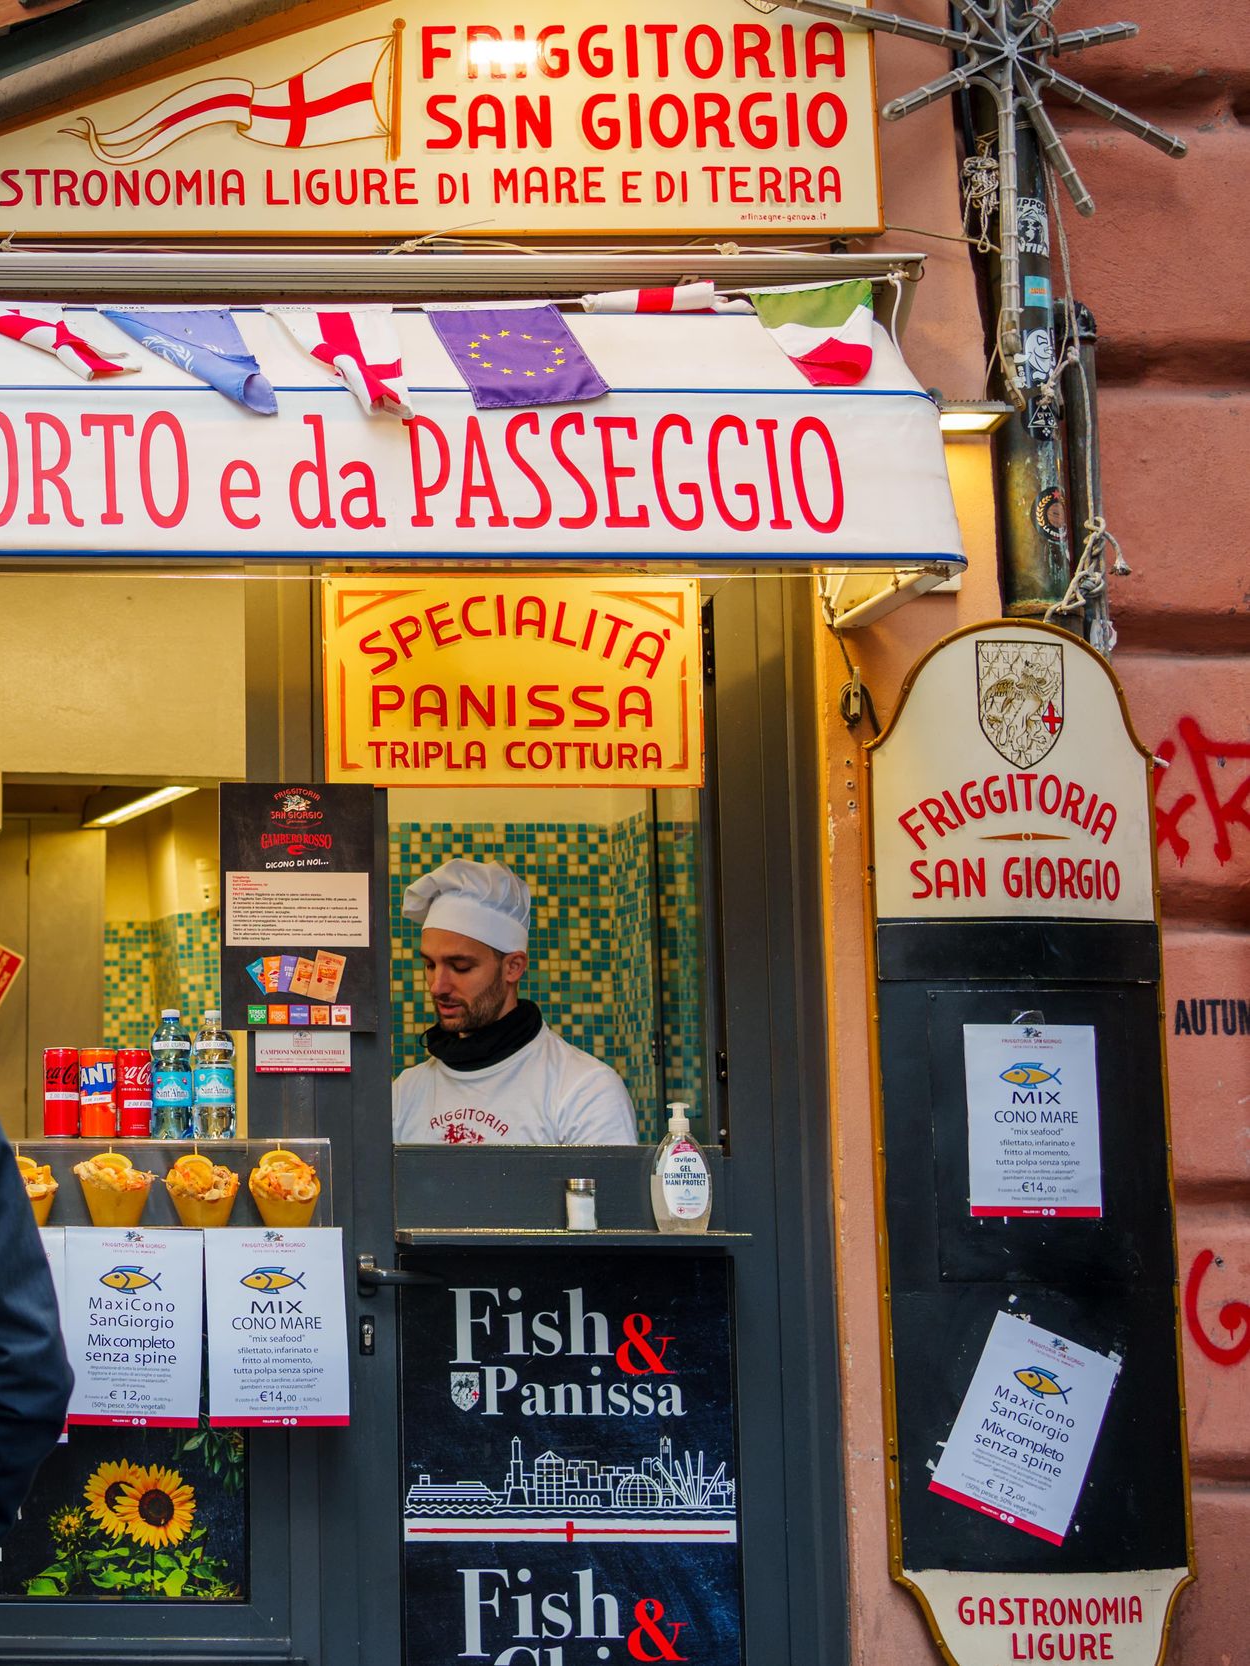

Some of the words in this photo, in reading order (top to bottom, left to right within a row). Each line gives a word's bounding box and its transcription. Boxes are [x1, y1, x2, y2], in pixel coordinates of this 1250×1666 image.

[421, 21, 846, 80] FRIGGITORIA
[425, 93, 552, 150] SAN
[580, 91, 848, 151] GIORGIO
[266, 167, 419, 206] LIGURE
[438, 172, 469, 205] DI
[492, 166, 606, 205] MARE
[621, 171, 642, 204] E
[655, 170, 688, 204] DI
[702, 165, 842, 204] TERRA
[219, 459, 261, 530] e
[288, 414, 387, 530] da
[401, 411, 844, 535] PASSEGGIO
[358, 594, 671, 680] SPECIALITÀ
[371, 684, 653, 728] PANISSA
[367, 740, 487, 769] TRIPLA
[505, 741, 663, 770] COTTURA
[273, 787, 321, 801] FRIGGITORIA
[270, 811, 286, 819] SAN
[287, 811, 324, 819] GIORGIO
[898, 773, 1117, 851] FRIGGITORIA
[260, 833, 303, 849] GAMBERO
[303, 833, 333, 850] ROSSO
[265, 860, 295, 869] DICONO
[910, 857, 986, 899] SAN
[1002, 856, 1120, 901] GIORGIO
[1012, 1091, 1061, 1105] MIX
[429, 1108, 509, 1137] RIGGITORIA
[994, 1110, 1036, 1124] CONO
[1040, 1110, 1079, 1124] MARE
[1016, 1159, 1037, 1167] polpa
[1061, 1159, 1080, 1167] spine
[682, 1179, 706, 1187] PROTECT
[88, 1296, 175, 1313] MaxiCono
[251, 1300, 303, 1315] MIX
[89, 1313, 174, 1332] SanGiorgio
[231, 1316, 277, 1331] CONO
[280, 1316, 323, 1330] MARE
[448, 1287, 615, 1364] Fish
[615, 1313, 676, 1375] &
[87, 1333, 112, 1347] Mix
[113, 1335, 176, 1351] completo
[249, 1334, 268, 1343] "mix
[269, 1334, 305, 1343] seafood"
[85, 1351, 129, 1363] senza
[134, 1351, 177, 1367] spine
[254, 1367, 277, 1375] polpa
[302, 1367, 324, 1375] spine
[109, 1390, 118, 1400] €
[122, 1390, 151, 1402] 12,00
[259, 1391, 297, 1403] €14,00
[480, 1365, 688, 1416] Panissa
[994, 1385, 1076, 1429] MaxiCono
[990, 1401, 1070, 1444] SanGiorgio
[981, 1418, 1006, 1437] Mix
[1007, 1432, 1064, 1461] completo
[974, 1434, 1018, 1459] senza
[1021, 1454, 1061, 1477] spine
[987, 1479, 995, 1488] €
[999, 1484, 1026, 1502] 12,00
[456, 1568, 625, 1657] Fish
[627, 1598, 689, 1662] &
[958, 1595, 1143, 1626] GASTRONOMIA
[1011, 1632, 1114, 1661] LIGURE
